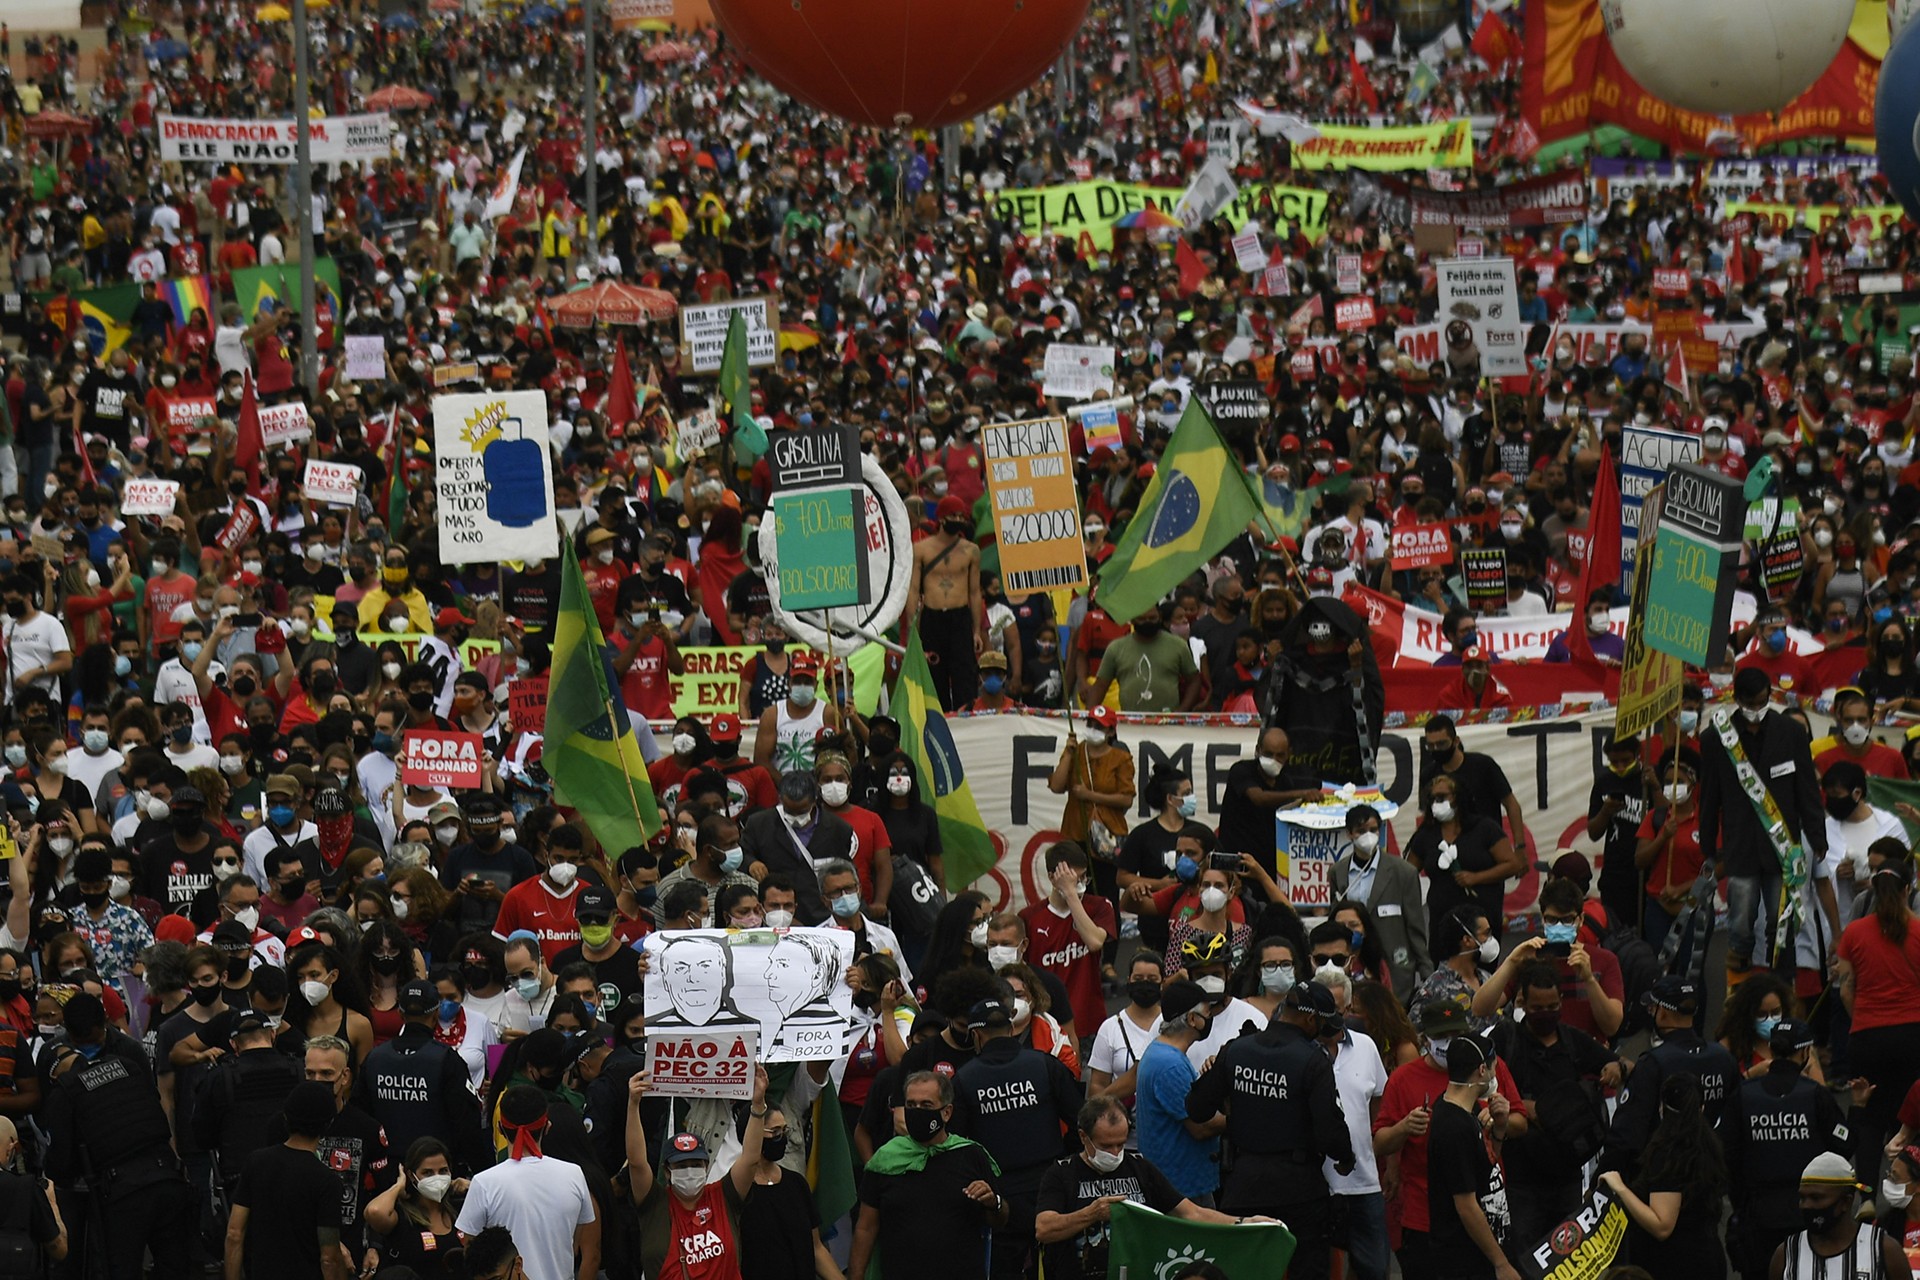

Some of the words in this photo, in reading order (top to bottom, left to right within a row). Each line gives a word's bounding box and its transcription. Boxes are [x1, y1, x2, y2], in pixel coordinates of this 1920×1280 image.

[164, 121, 278, 141] DEMOCRACIA
[287, 124, 329, 142] SM,
[179, 143, 218, 158] ELE
[233, 141, 299, 159] NÃO!
[996, 191, 1086, 229] PELA
[1446, 270, 1481, 283] Feijão
[1482, 270, 1506, 281] sim,
[1450, 286, 1477, 298] fuzil
[1479, 285, 1504, 297] não!
[687, 310, 707, 323] LIRA
[717, 304, 764, 320] CÚPLICE
[1336, 301, 1373, 316] FORA
[1486, 330, 1515, 342] Fora
[168, 400, 215, 418] FORA
[261, 409, 289, 424] NÃO
[263, 420, 289, 432] PEC
[290, 417, 308, 429] 32
[984, 421, 1060, 459] ENERGIA
[774, 432, 842, 469] GASOLINA
[439, 456, 484, 470] OFERTA
[310, 465, 340, 479] NÃO
[454, 471, 470, 481] DO
[128, 482, 159, 494] NÃO
[309, 477, 337, 490] PEC
[128, 494, 153, 504] PEC
[996, 488, 1034, 509] VALOR
[1666, 471, 1723, 521] GASOLINA
[447, 497, 485, 512] TUDO
[221, 508, 251, 549] FORA
[445, 515, 476, 528] MAIS
[453, 531, 483, 543] CARO
[1392, 529, 1447, 548] FORA
[1568, 535, 1585, 549] FO
[1392, 544, 1448, 559] BOLSONARO
[1479, 560, 1502, 570] TUDO
[781, 564, 859, 595] BOLSOCARO
[1650, 603, 1710, 654] BOLSOCARO
[408, 738, 477, 760] FORA
[407, 758, 477, 773] BOLSONARO
[1012, 735, 1242, 825] FME
[1289, 829, 1340, 850] PREVENT
[1290, 844, 1329, 860] SENIOR
[167, 873, 213, 887] PUBLIC
[796, 1031, 832, 1043] FORA
[655, 1038, 718, 1059] NÃO
[728, 1035, 748, 1058] À
[795, 1045, 833, 1057] BOZO
[653, 1061, 709, 1077] PEC
[715, 1061, 748, 1077] 32
[1235, 1065, 1288, 1087] POLÍCIA
[85, 1069, 126, 1089] MILITAR
[377, 1074, 428, 1089] POLÍCIA
[1701, 1073, 1724, 1087] ÍCIA
[377, 1088, 428, 1101] MILITAR
[977, 1079, 1035, 1101] POLÍCIA
[1234, 1079, 1288, 1100] MILITAR
[980, 1093, 1038, 1115] MILITAR
[1750, 1111, 1808, 1127] POLÍCIA
[1752, 1127, 1810, 1141] MILITAR
